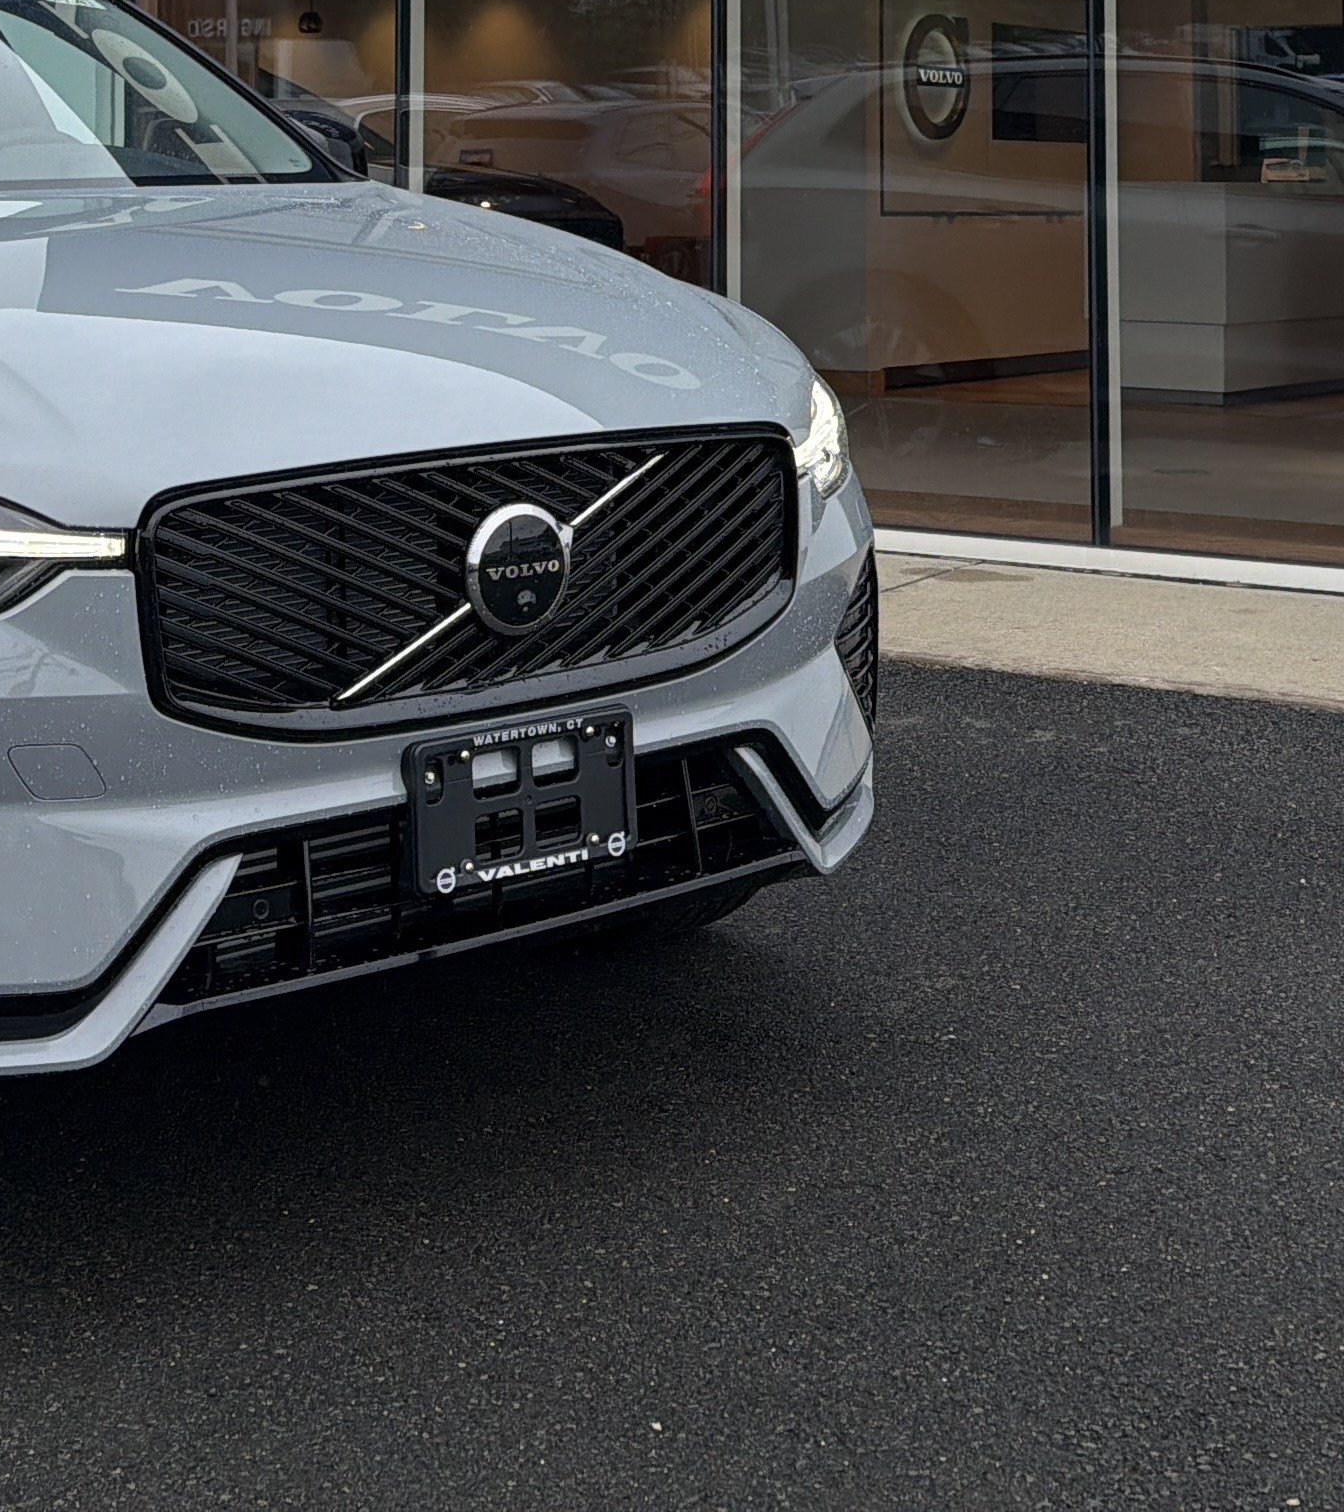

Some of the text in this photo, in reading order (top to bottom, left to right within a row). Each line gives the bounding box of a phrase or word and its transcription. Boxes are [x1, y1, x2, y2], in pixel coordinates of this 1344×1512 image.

[917, 68, 964, 85] VOLVO
[485, 559, 560, 581] VOLVO
[472, 717, 585, 747] WATERTOWN, CT
[476, 848, 590, 883] VALENTI
